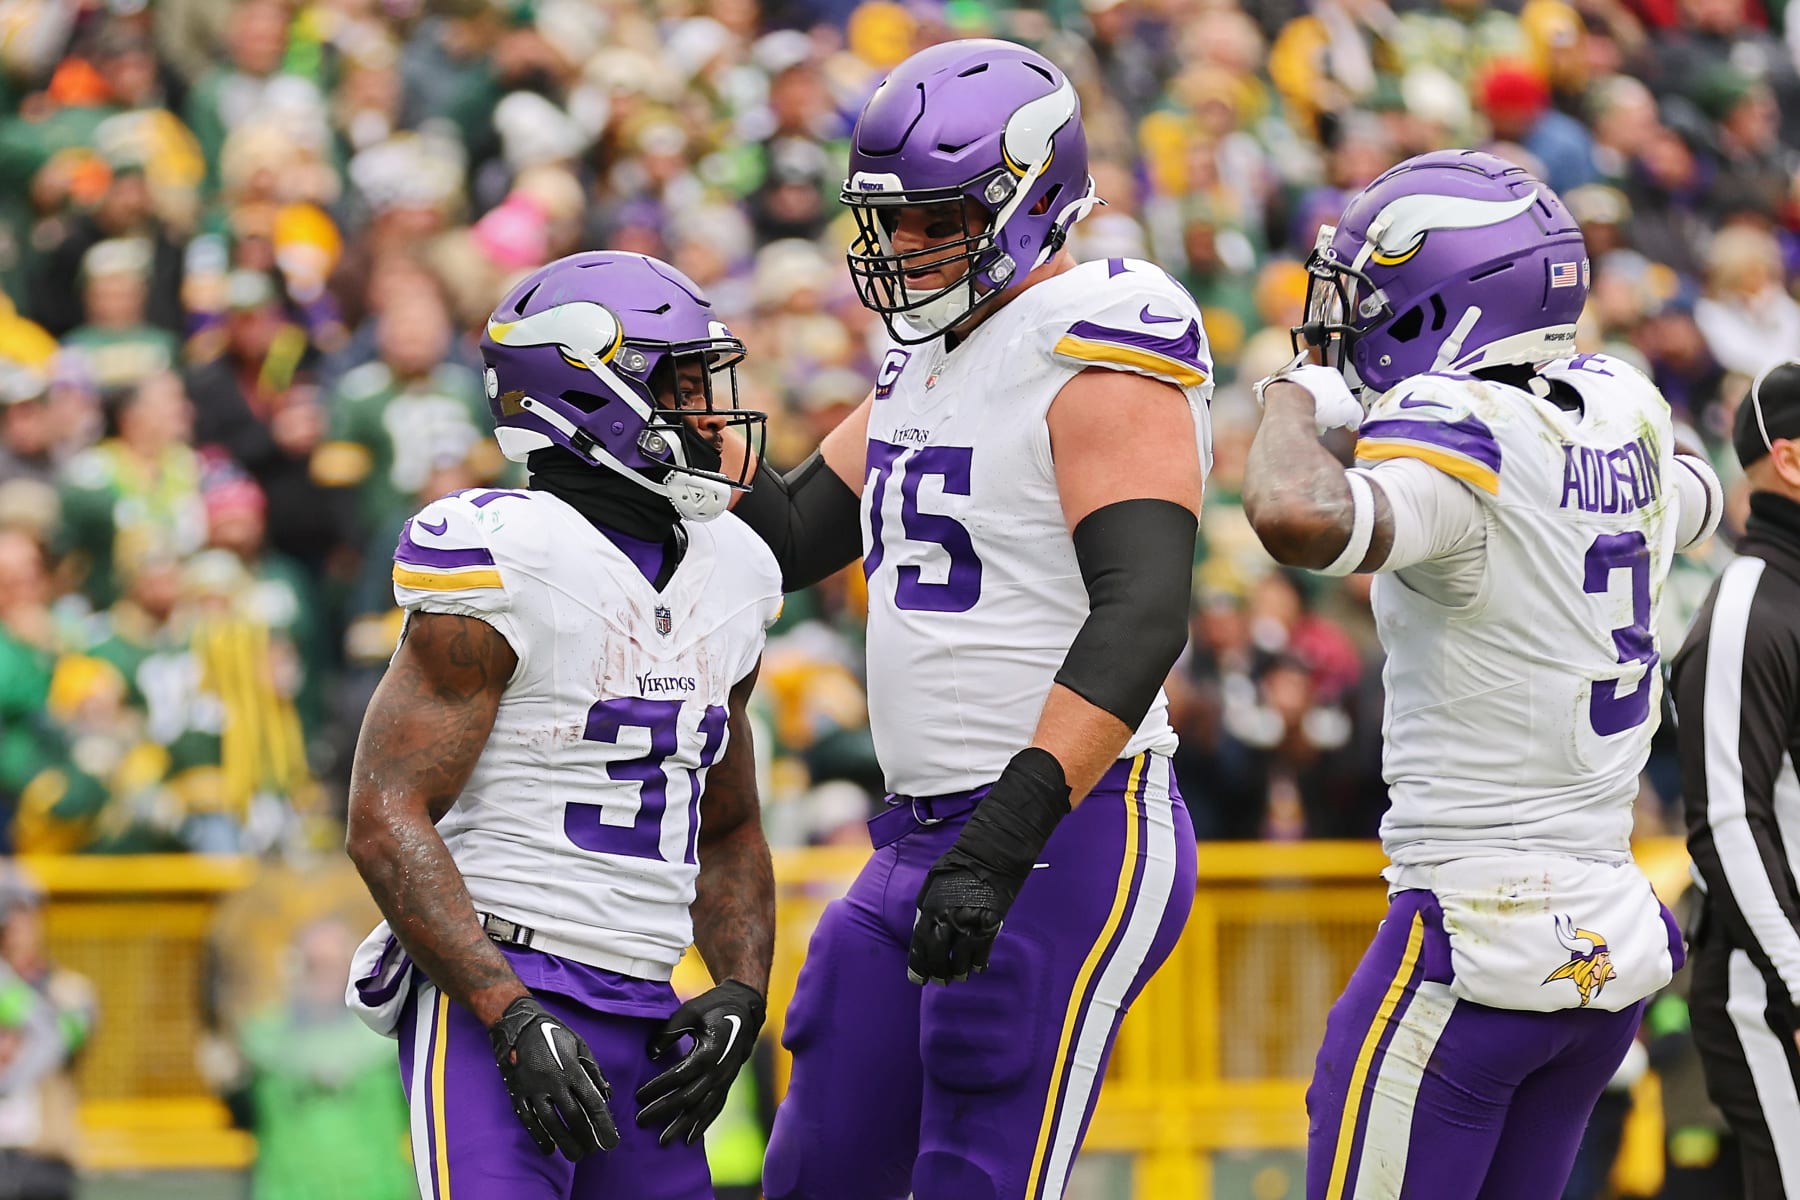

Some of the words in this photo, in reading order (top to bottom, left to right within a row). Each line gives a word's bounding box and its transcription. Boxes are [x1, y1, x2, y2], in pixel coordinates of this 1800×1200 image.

[878, 350, 907, 387] C
[864, 439, 982, 612] 75
[1583, 530, 1660, 737] 3
[564, 696, 728, 865] 31
